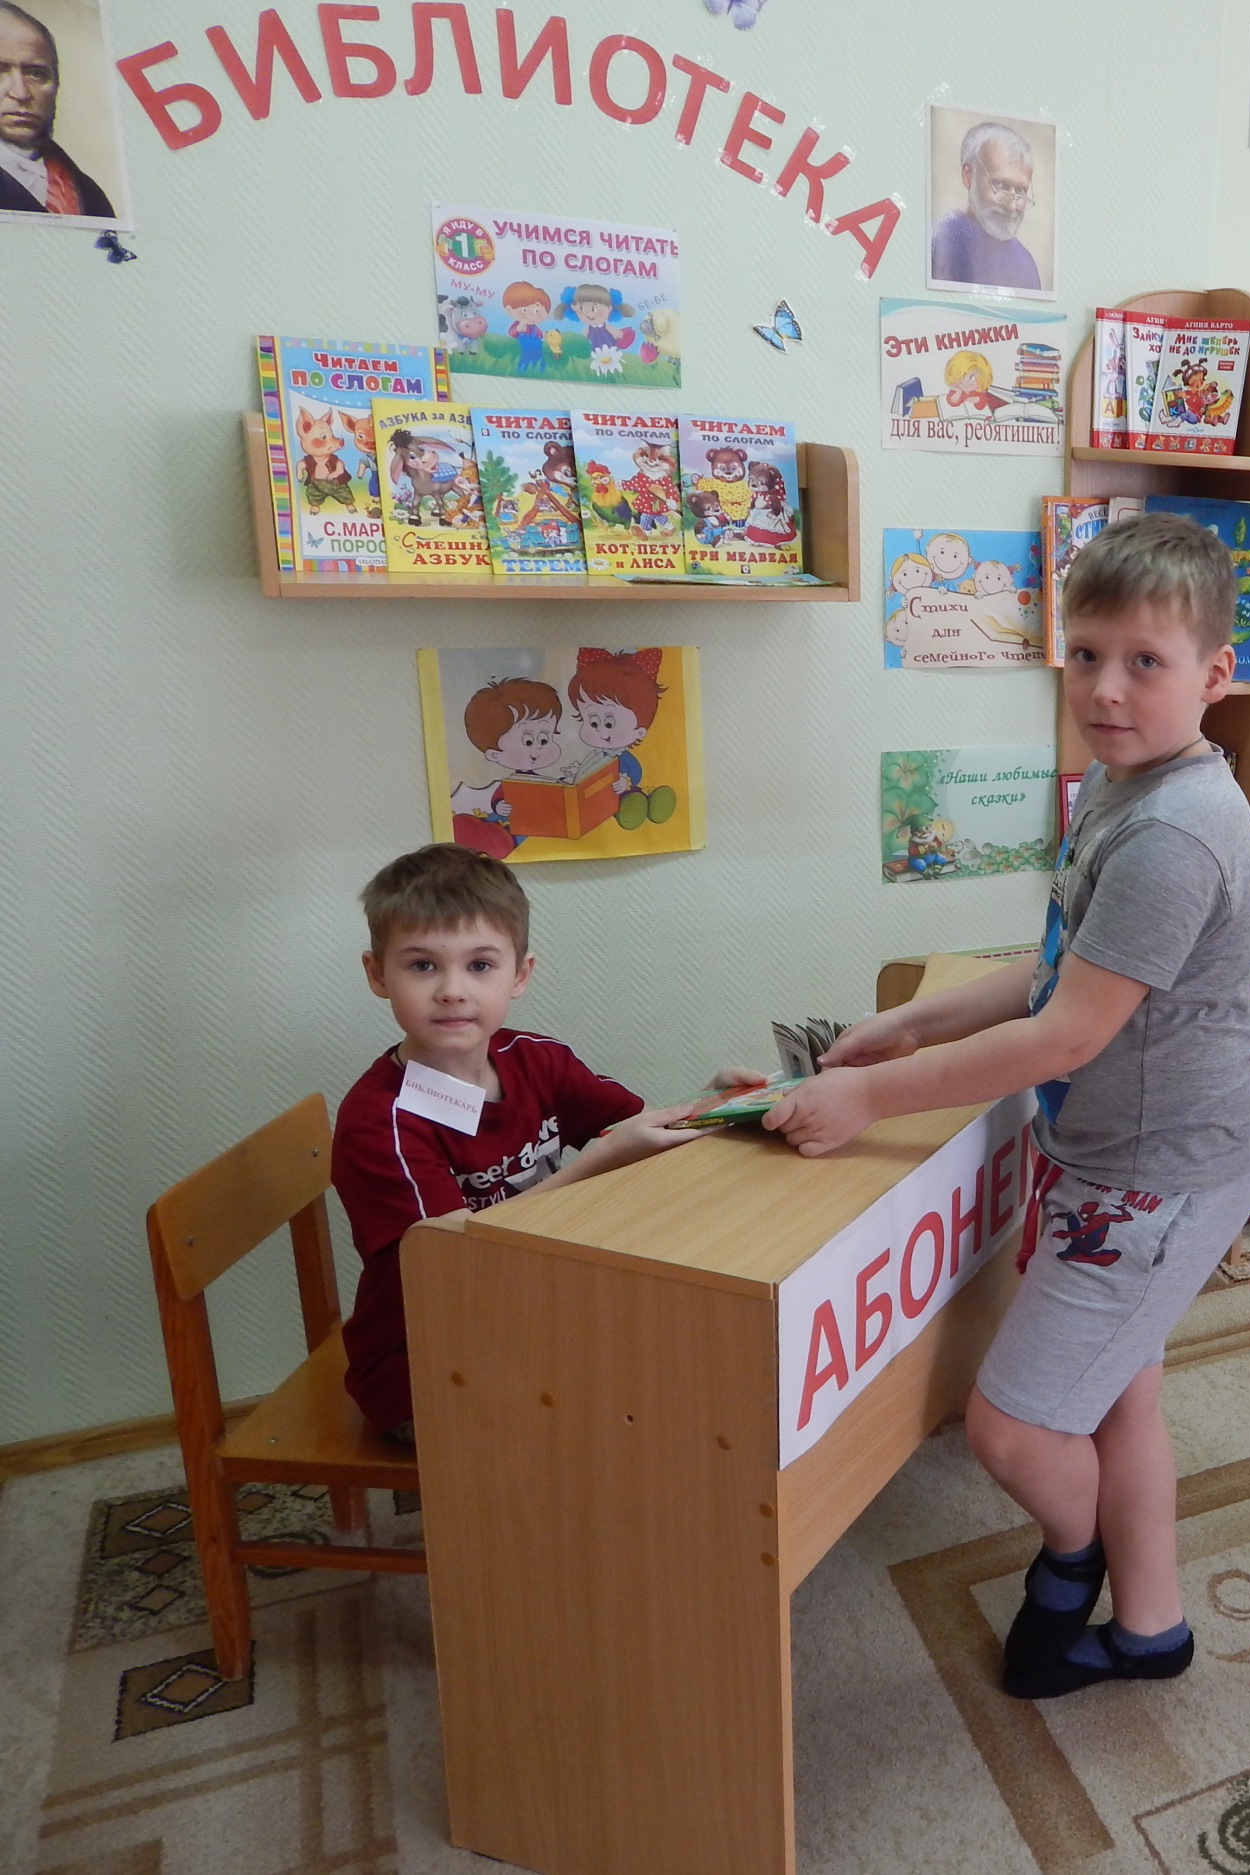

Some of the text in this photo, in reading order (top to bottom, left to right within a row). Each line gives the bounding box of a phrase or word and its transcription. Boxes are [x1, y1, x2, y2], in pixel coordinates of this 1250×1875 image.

[117, 2, 906, 281] БИБЛИОТЕКА
[451, 220, 474, 230] ИДУ
[492, 219, 591, 246] УЧИМСЯ
[454, 232, 470, 258] 1
[447, 257, 485, 272] КЛАСС
[521, 248, 658, 278] ПО СЛОГАМ
[450, 278, 496, 299] МУ-МУ
[637, 293, 668, 311] БЕ-БЕ
[1184, 321, 1234, 330] АГНИЯ БАРТО
[1182, 346, 1196, 355] ДО
[290, 369, 423, 395] ПО СЛОГАМ
[379, 412, 428, 430] АЗБУКА
[582, 413, 679, 429] ЧИТАЕМ
[690, 419, 787, 437] ЧИТАЕМ
[890, 412, 1062, 448] для вас, ребятишки!
[500, 431, 520, 440] ПО
[594, 428, 671, 440] ПО СЛОГАМ
[701, 434, 775, 446] ПО СЛОГАМ
[412, 553, 491, 566] АЗБУК
[629, 557, 676, 569] ЛИСА
[689, 550, 799, 564] ТРИ МЕДВЕДЯ
[909, 596, 968, 619] Стихи
[913, 650, 996, 664] семейного
[938, 766, 1057, 786] «Наши любимые
[970, 791, 1026, 806] сказки»
[405, 1079, 477, 1113] БИБЛИОТЕКАРЬ
[1121, 1190, 1163, 1214] MAN
